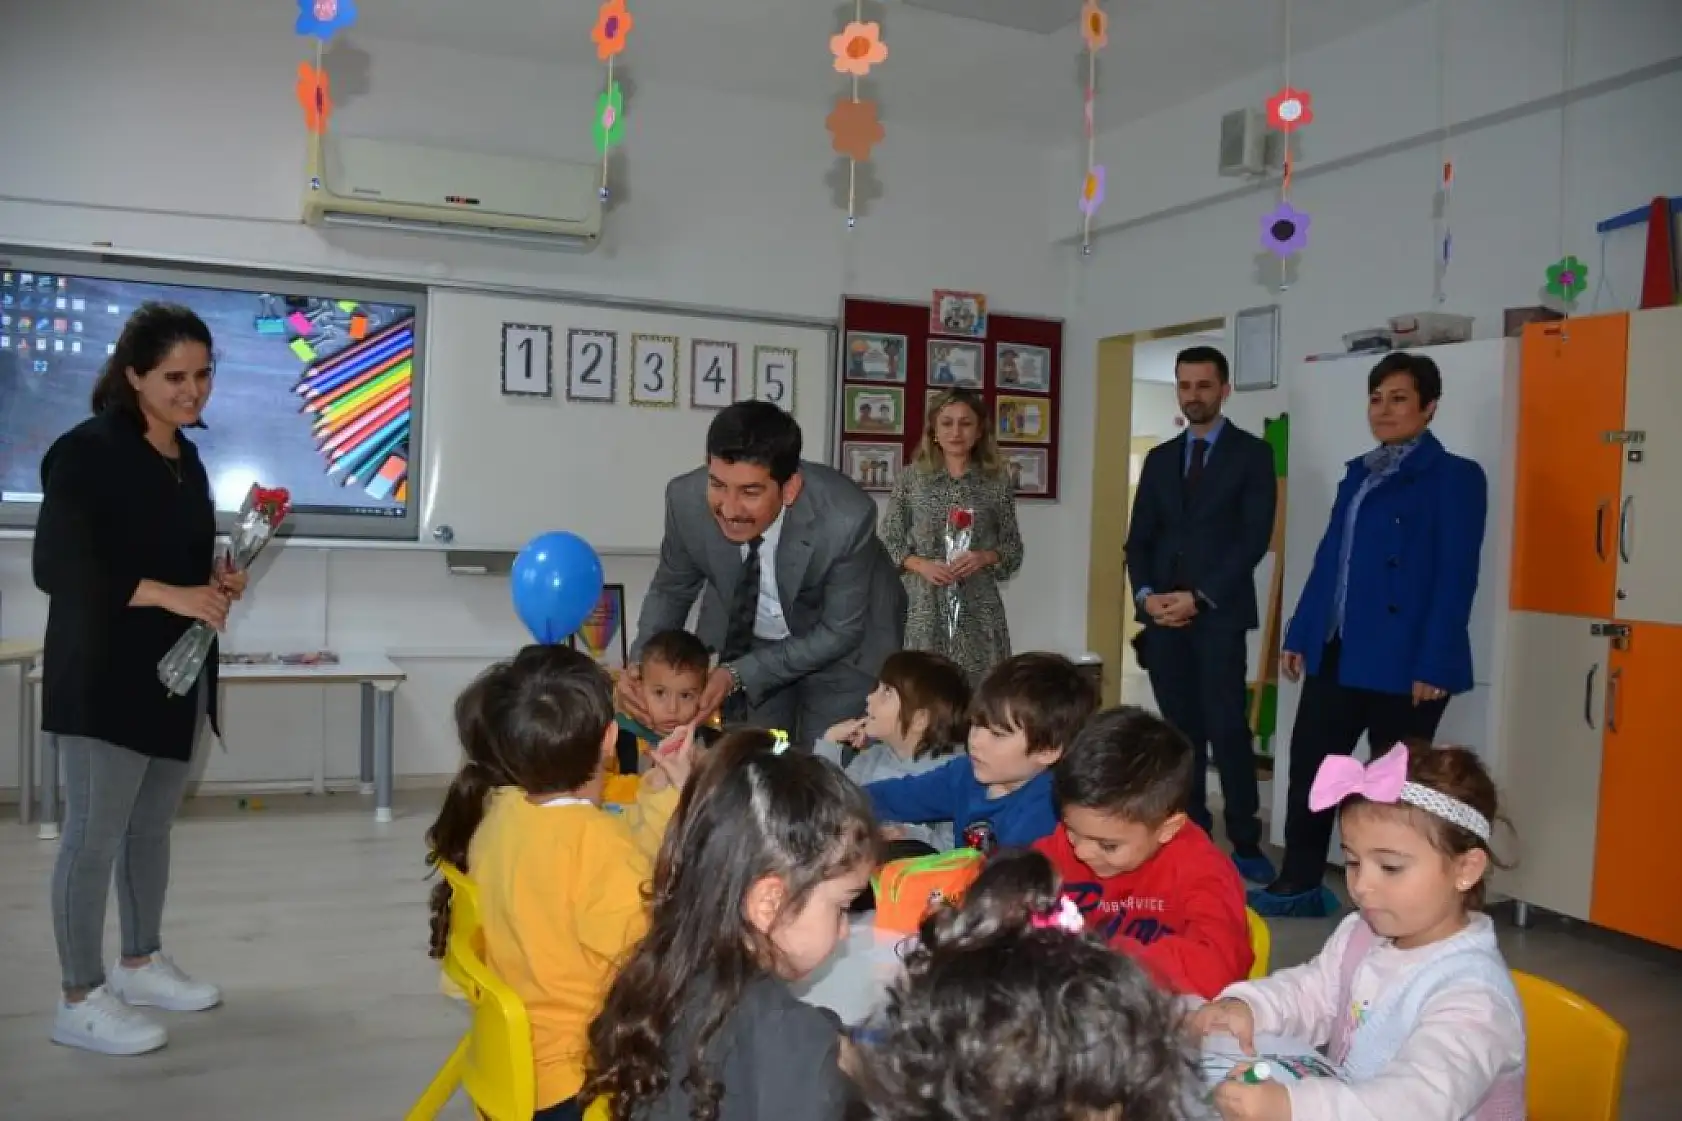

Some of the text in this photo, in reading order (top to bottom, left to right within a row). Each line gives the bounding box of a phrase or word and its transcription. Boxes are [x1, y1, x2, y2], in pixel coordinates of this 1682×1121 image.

[518, 337, 532, 379] 1
[580, 342, 603, 384] 2
[643, 352, 664, 392] 3
[702, 356, 726, 393] 4
[765, 363, 784, 402] 5
